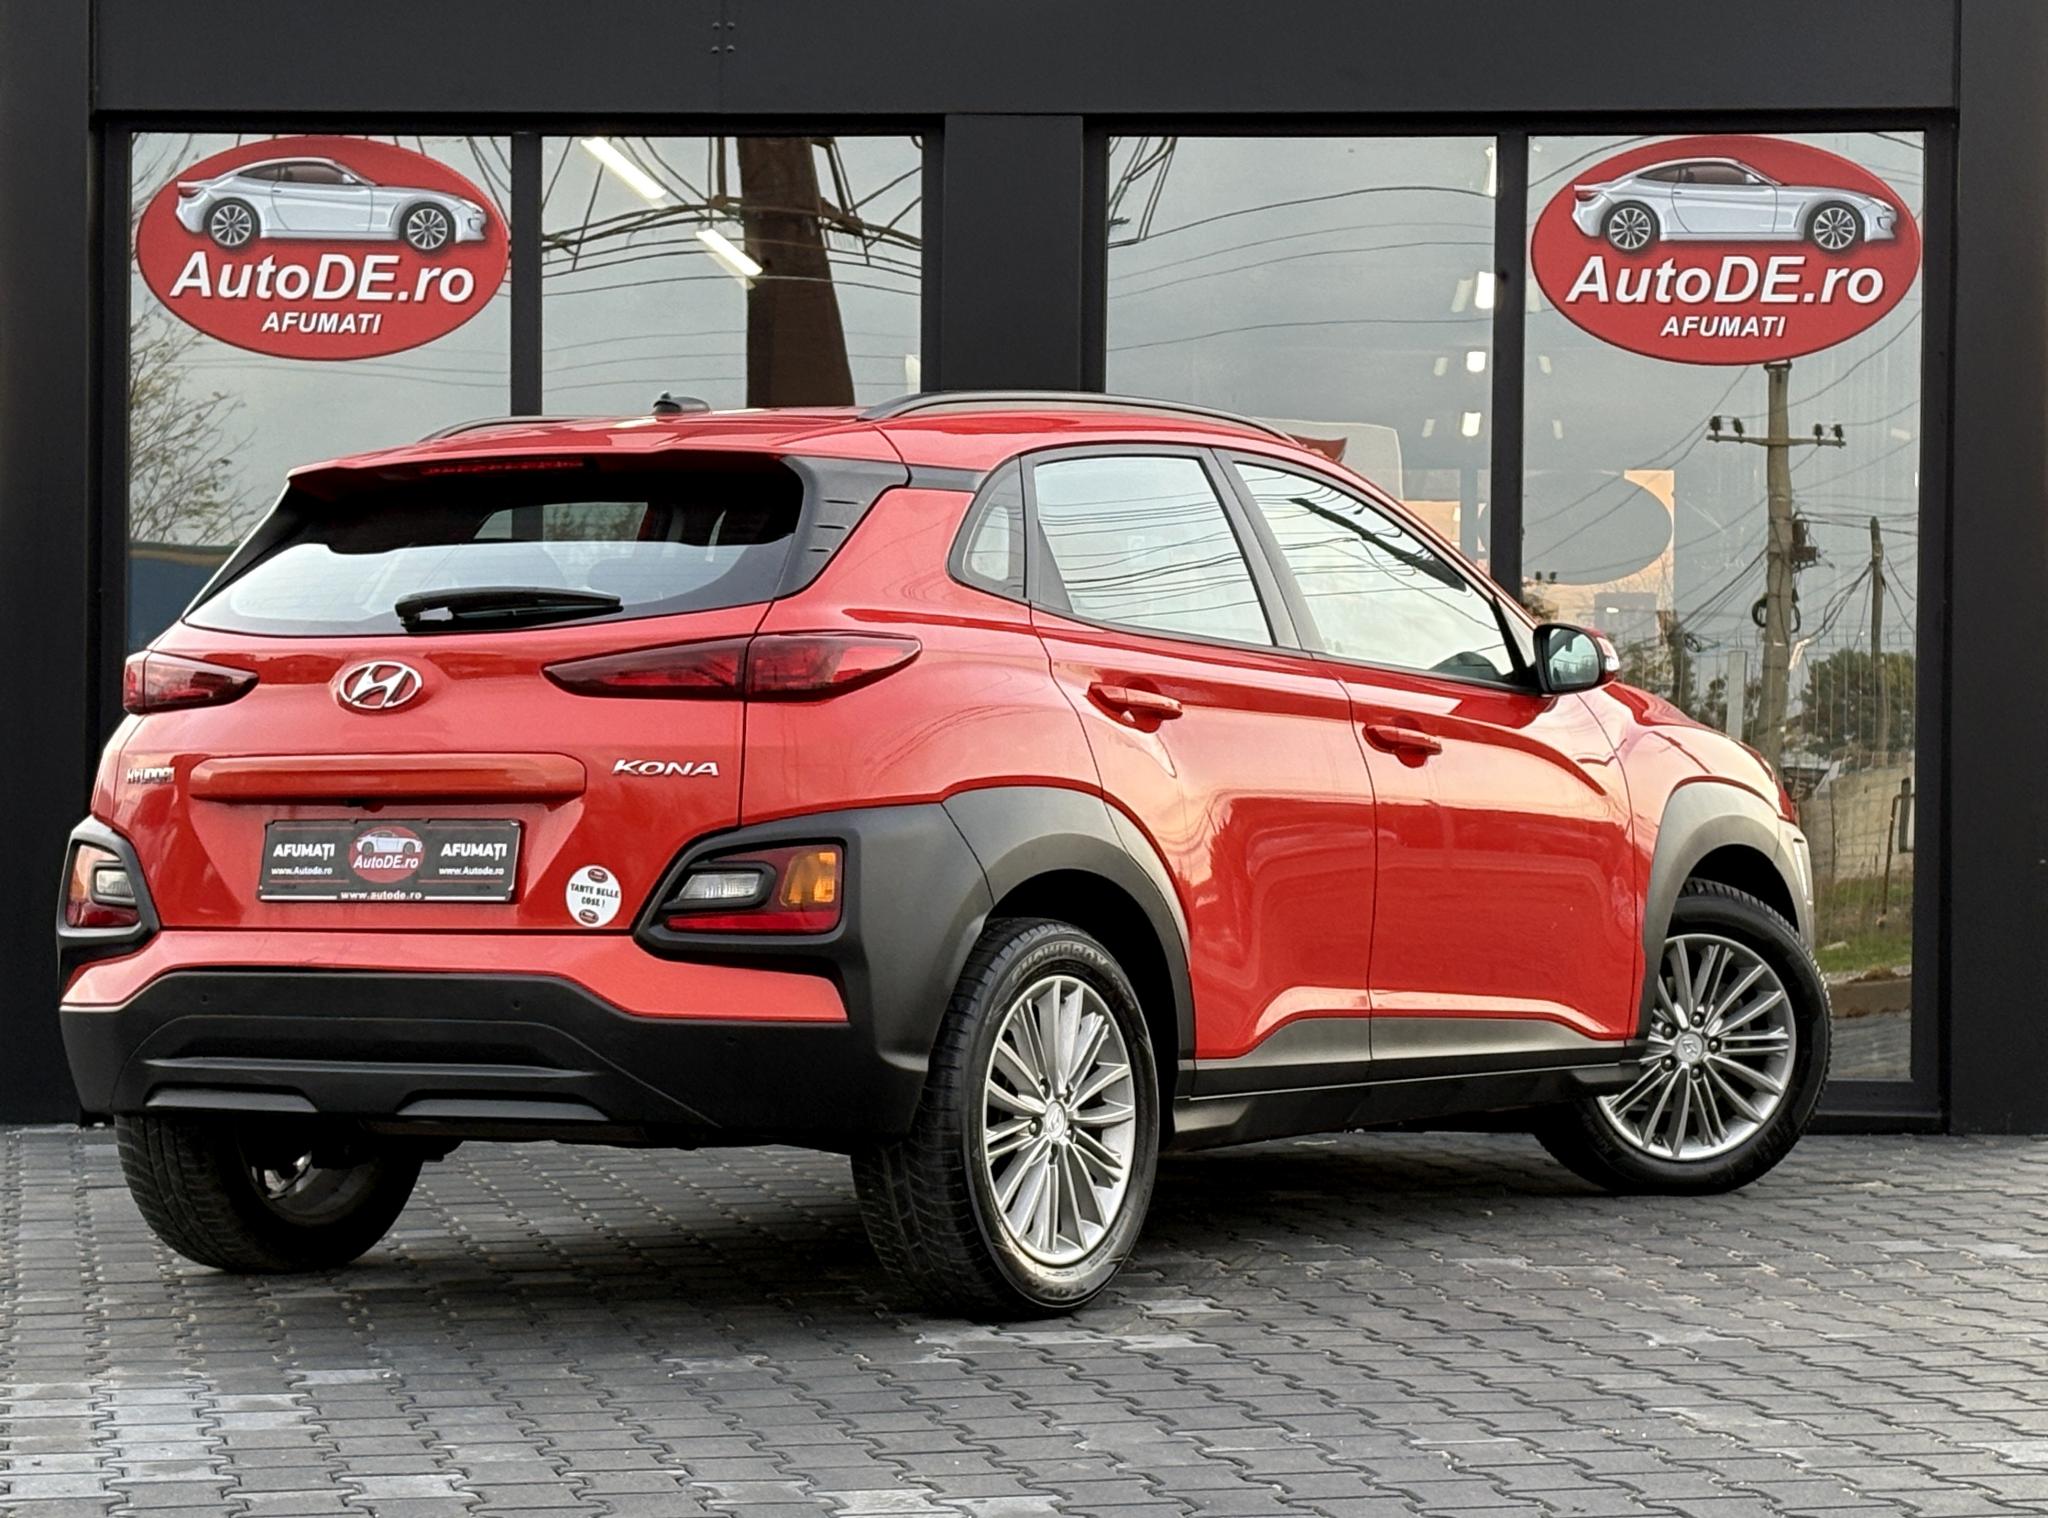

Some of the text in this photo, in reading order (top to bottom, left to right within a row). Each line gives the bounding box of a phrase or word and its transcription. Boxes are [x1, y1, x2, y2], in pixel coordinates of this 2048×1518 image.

[170, 251, 475, 304] AutoDE.ro
[1565, 255, 1885, 305] AutoDE.ro
[261, 312, 383, 335] AFUMATI
[1660, 316, 1787, 338] AFUMATI
[611, 759, 720, 776] KONA
[353, 854, 419, 869] AutoDE.ro
